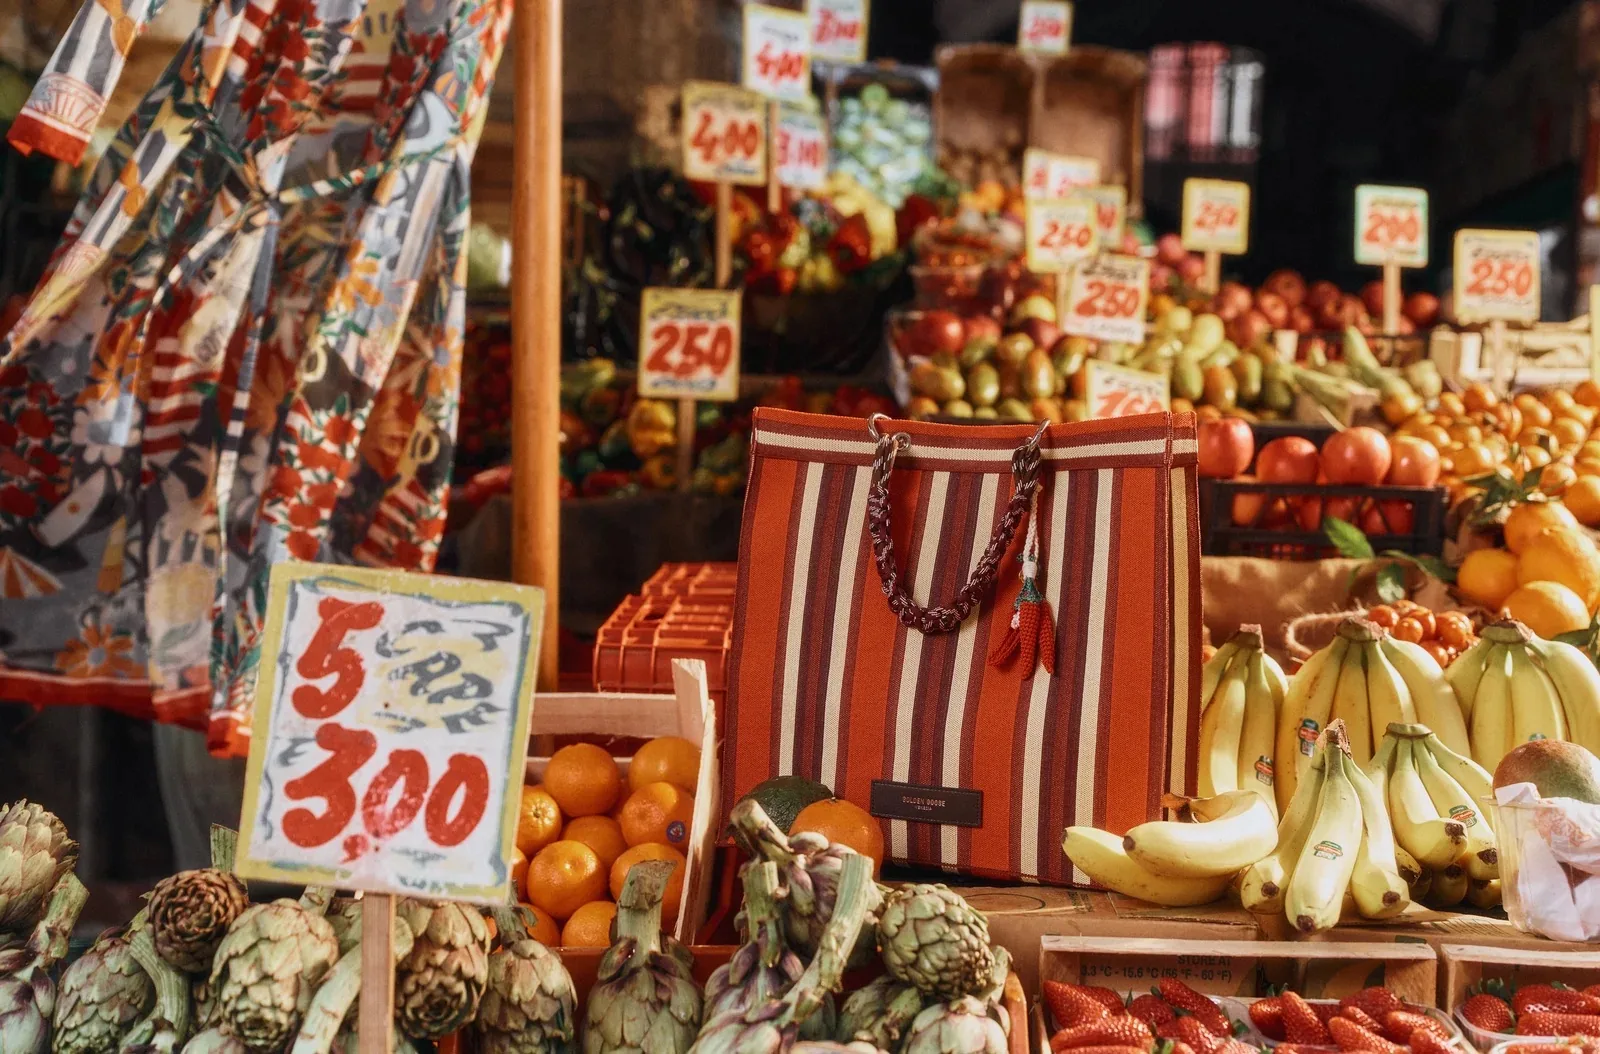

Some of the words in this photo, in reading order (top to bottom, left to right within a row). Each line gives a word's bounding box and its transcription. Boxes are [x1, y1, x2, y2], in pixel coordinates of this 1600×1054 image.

[1177, 955, 1215, 966] STORE
[1218, 956, 1231, 966] AT
[1123, 966, 1144, 978] 15.6
[1201, 970, 1213, 980] 60
